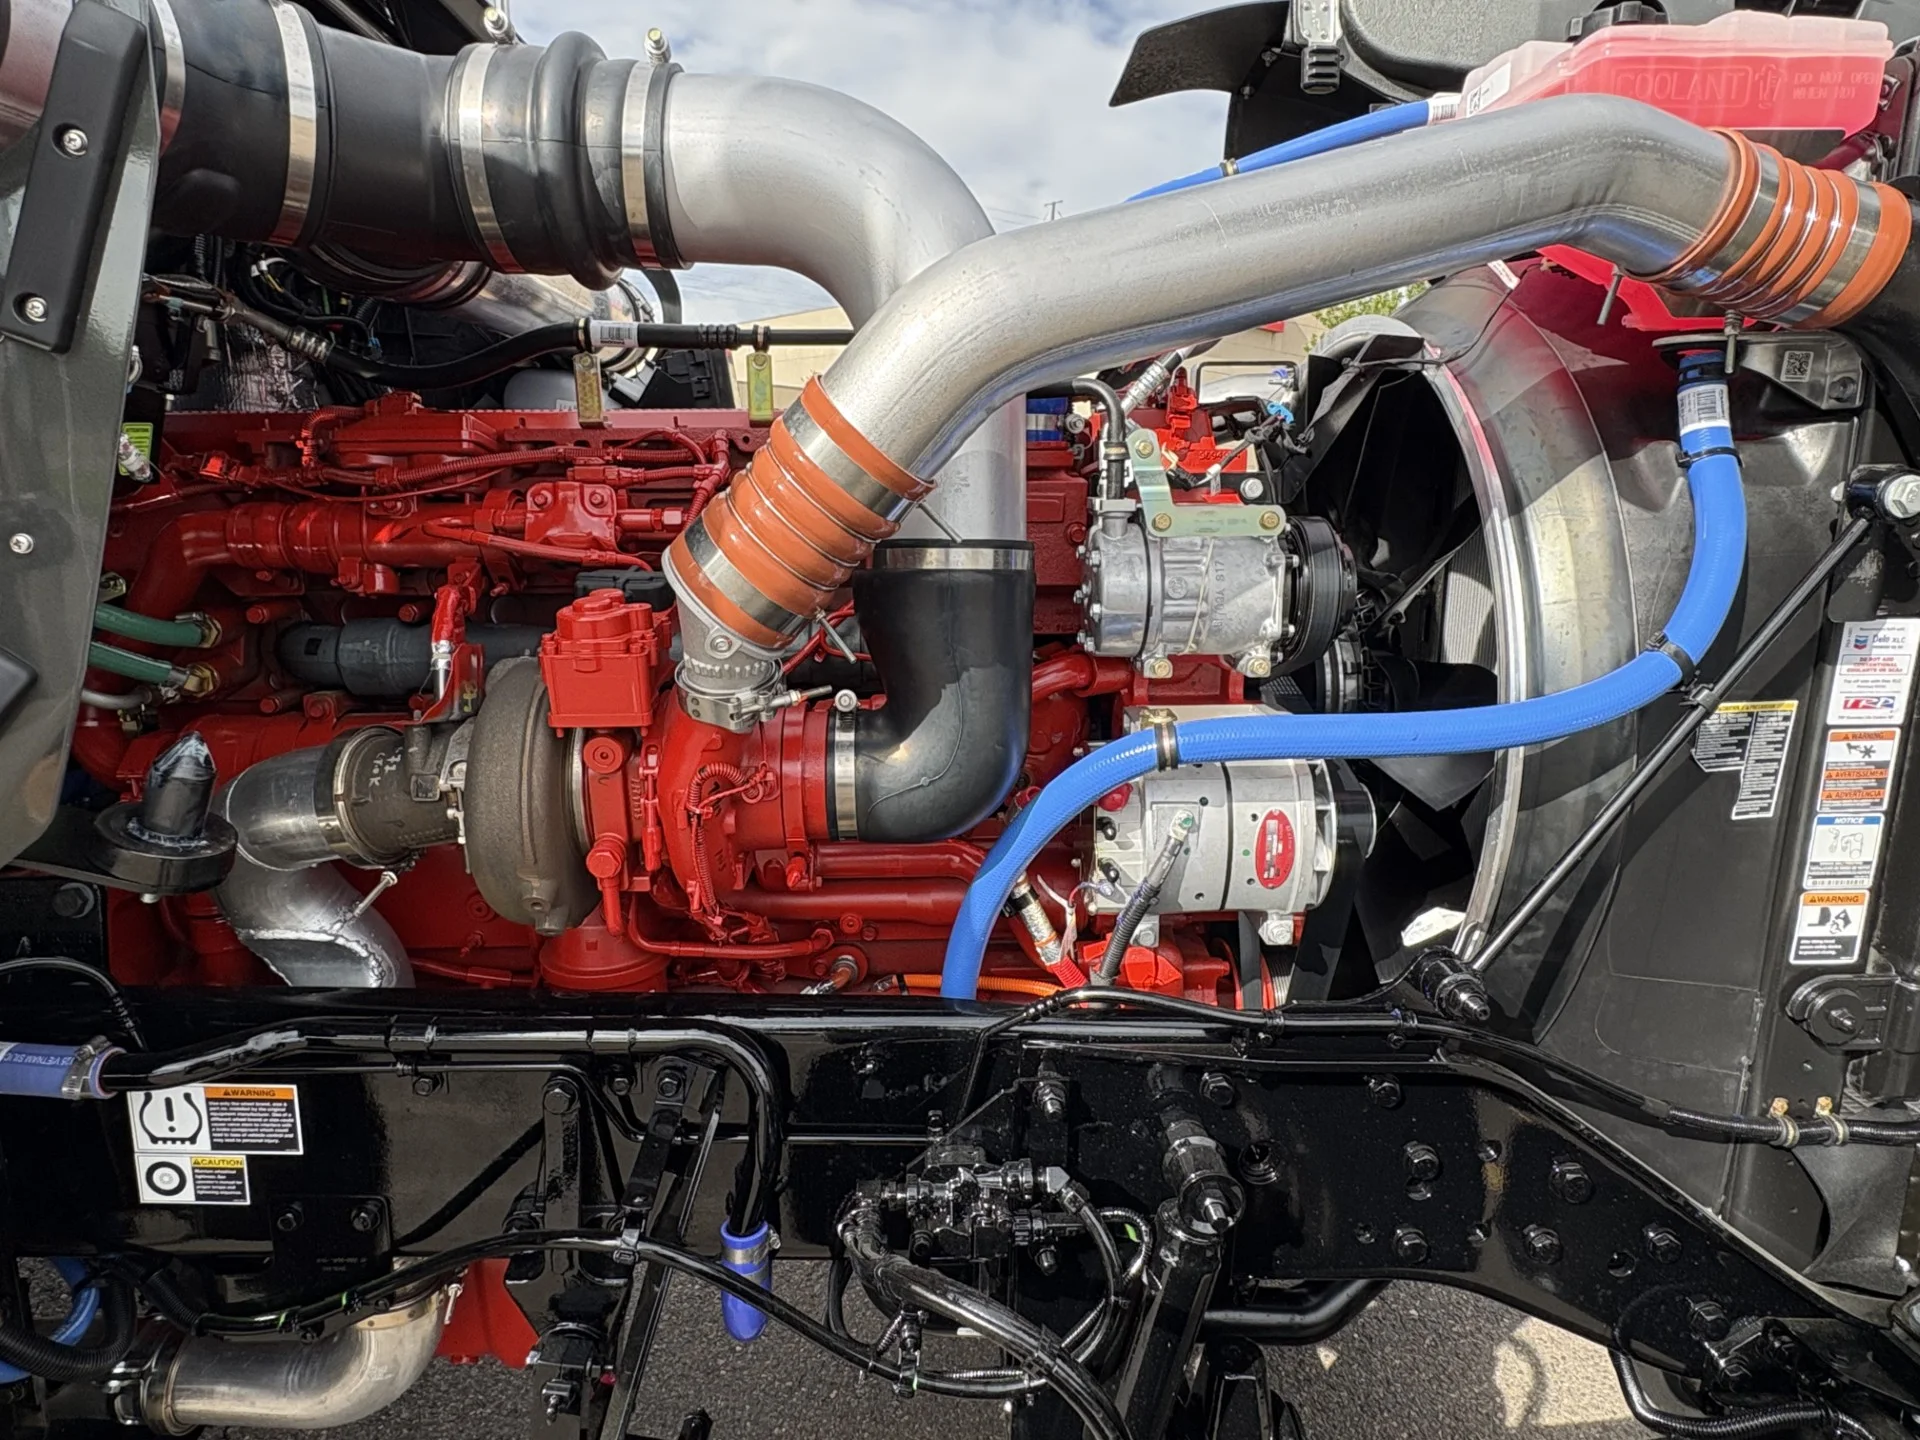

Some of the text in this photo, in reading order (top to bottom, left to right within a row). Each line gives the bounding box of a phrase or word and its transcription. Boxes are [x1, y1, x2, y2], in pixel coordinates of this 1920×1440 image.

[1794, 72, 1813, 85] DO
[1616, 71, 1745, 100] COOLANT
[1844, 696, 1894, 709] TRP
[1851, 732, 1884, 740] WARNING
[1835, 769, 1888, 777] AVERTISSEMENT
